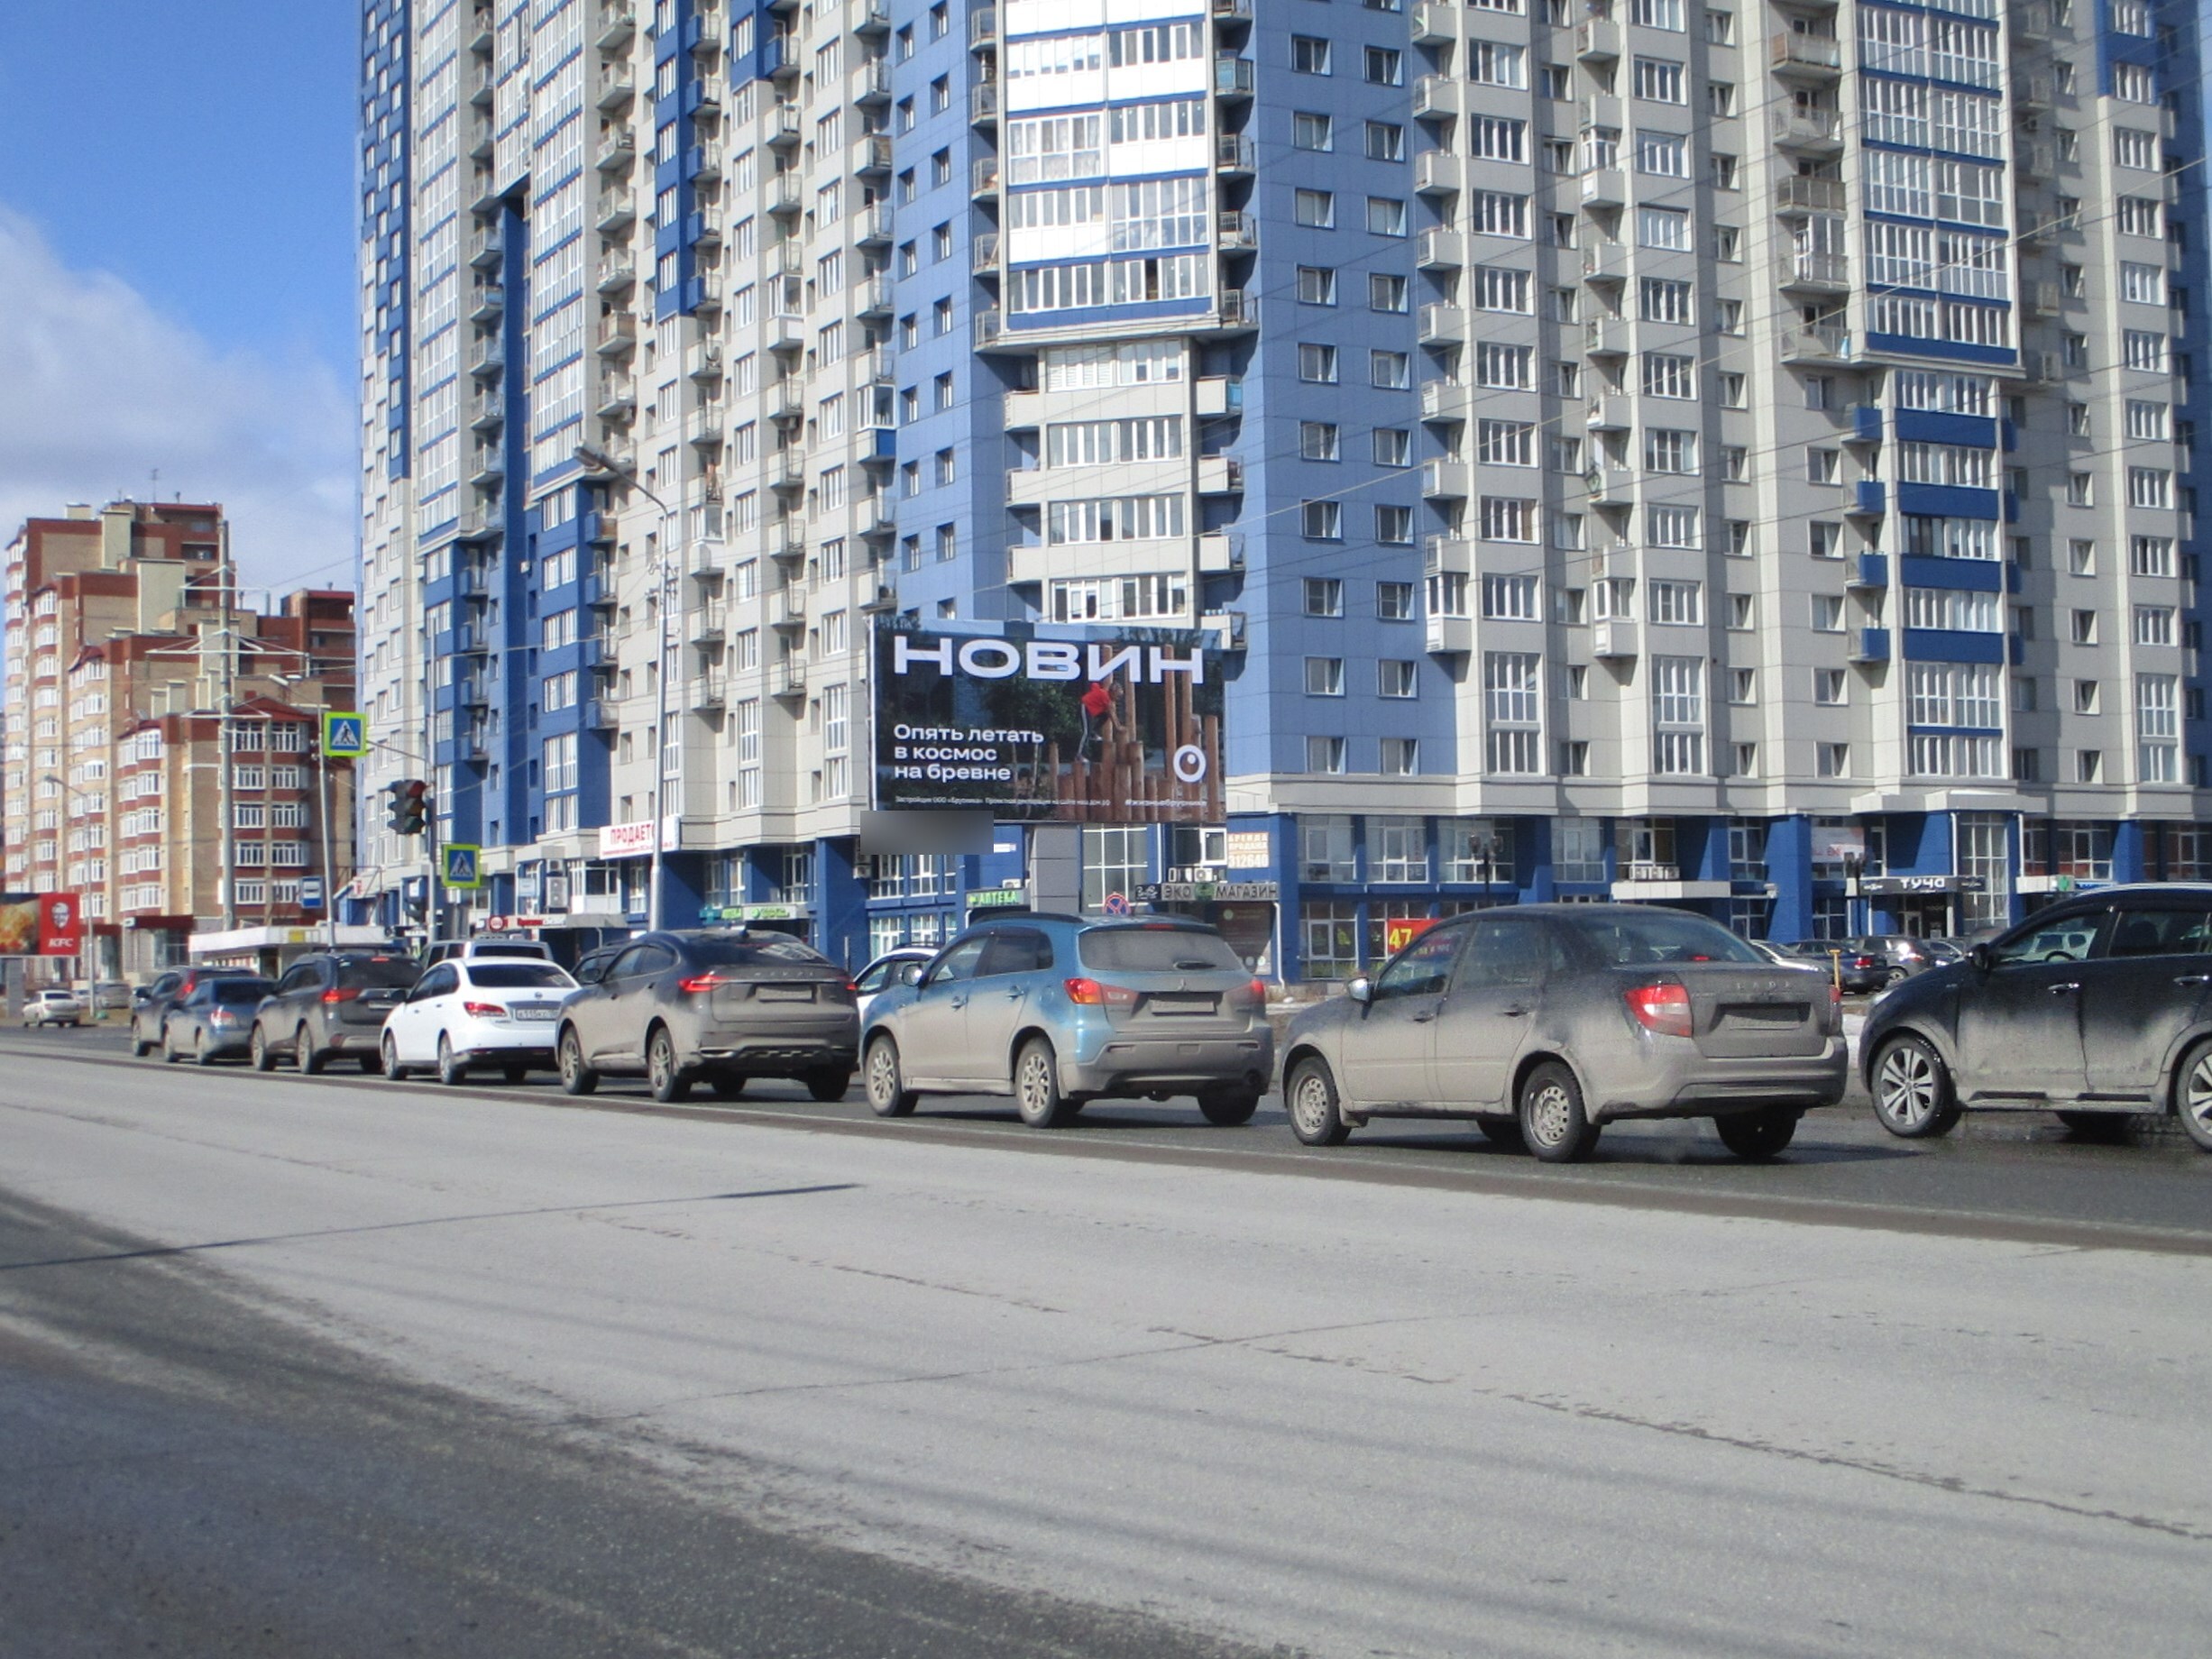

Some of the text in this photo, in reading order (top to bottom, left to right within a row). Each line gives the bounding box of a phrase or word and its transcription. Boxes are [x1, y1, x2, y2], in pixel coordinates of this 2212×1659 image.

[894, 636, 1204, 684] НОВИН
[895, 724, 1044, 744] Опять летать
[895, 747, 997, 762] в космос
[895, 764, 1011, 784] на бревне
[610, 822, 656, 847] ПРОДАЕТ
[979, 891, 1018, 906] АПТЕКА
[1165, 884, 1192, 897] ЭКО
[1217, 884, 1278, 898] МАГАЗИН
[48, 938, 74, 948] KFC
[1389, 928, 1412, 949] 47
